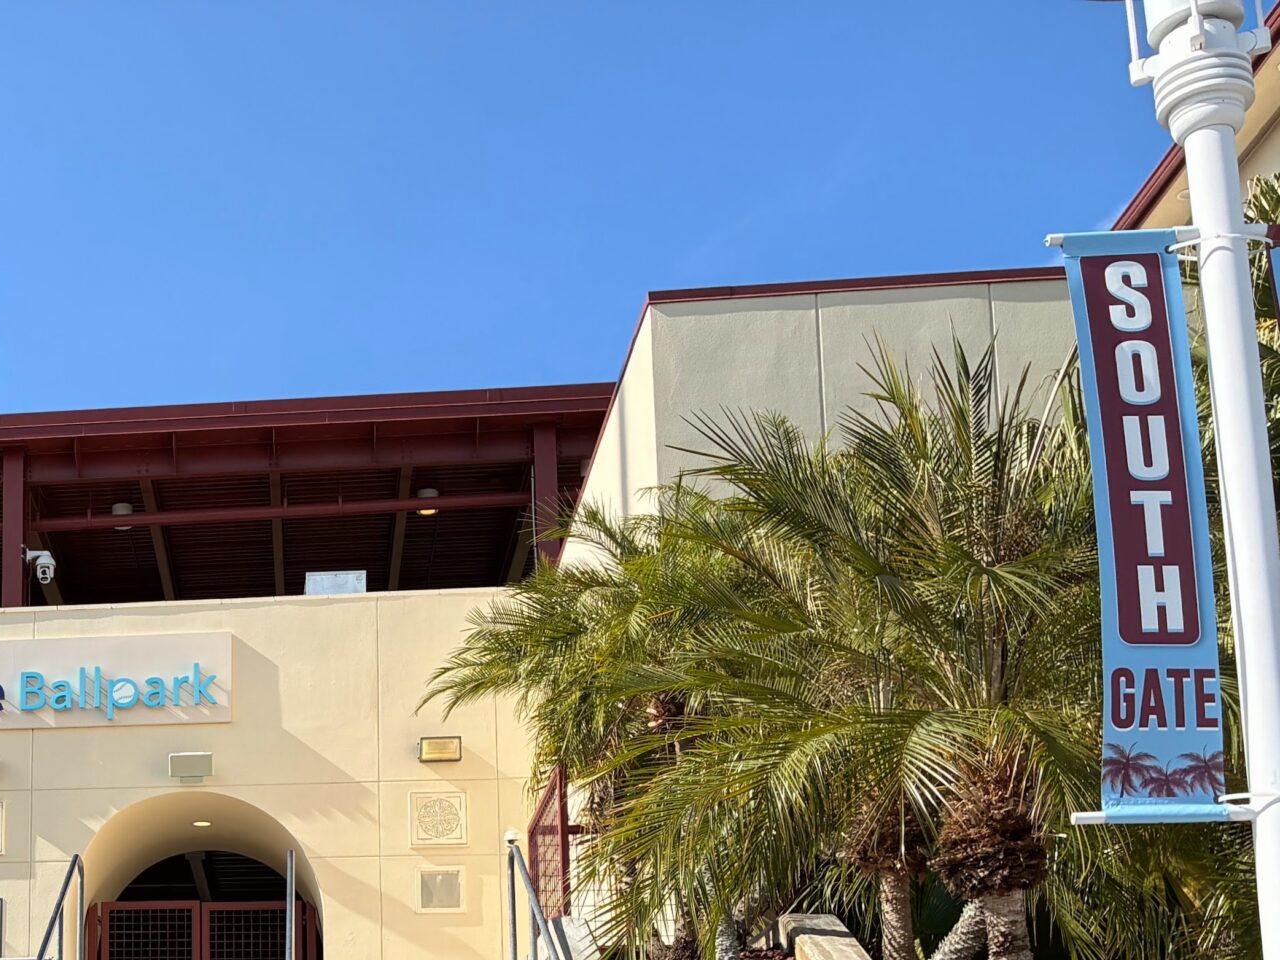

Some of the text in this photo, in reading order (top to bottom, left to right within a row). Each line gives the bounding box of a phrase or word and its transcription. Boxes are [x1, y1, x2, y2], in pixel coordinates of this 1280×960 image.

[1104, 260, 1184, 634] SOUTH
[19, 662, 218, 720] Ballpark
[1110, 667, 1219, 731] GATE
